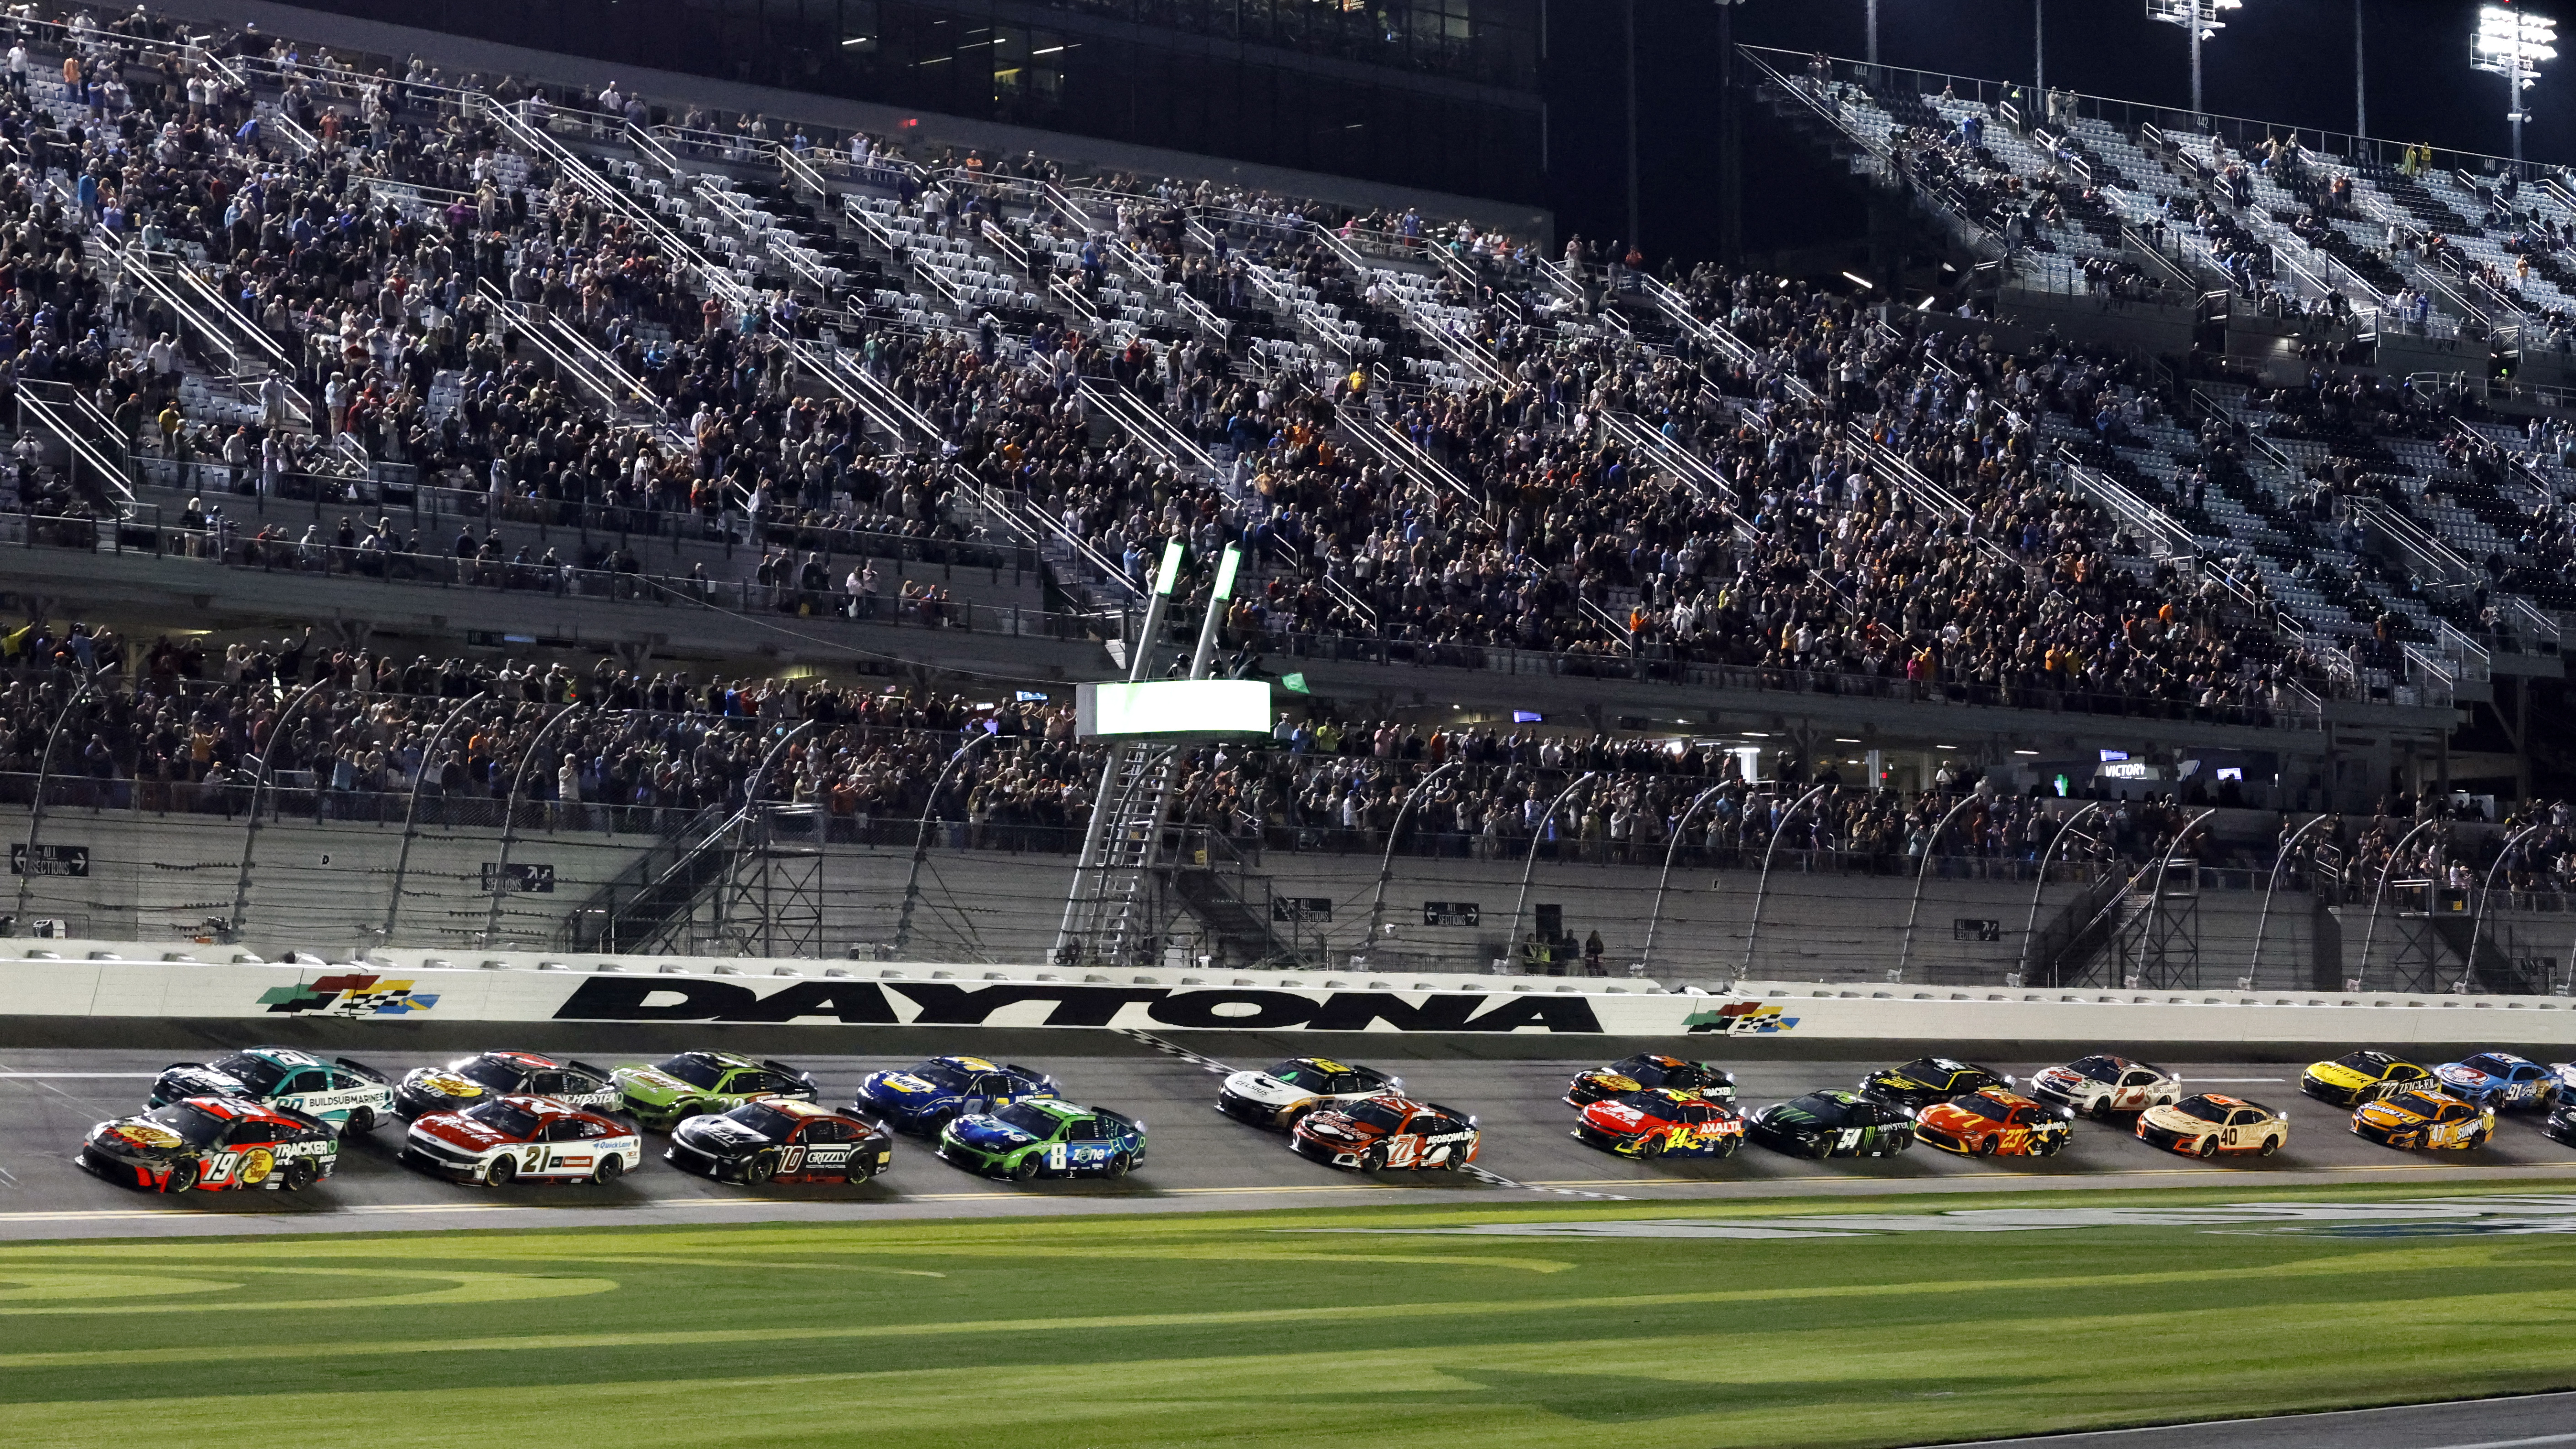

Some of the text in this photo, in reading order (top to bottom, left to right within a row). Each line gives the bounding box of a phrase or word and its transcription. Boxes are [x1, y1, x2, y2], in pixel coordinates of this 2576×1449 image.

[2197, 115, 2209, 128] 442
[2484, 158, 2495, 171] 440
[2106, 763, 2145, 777] VICTORY
[322, 855, 329, 865] D
[1300, 899, 1310, 910] ALL
[1438, 914, 1466, 926] SECTIONS
[552, 976, 1604, 1033] DAYTONA
[408, 1080, 446, 1098] CLUB
[894, 1077, 926, 1091] NAPA
[1235, 1080, 1269, 1096] CELSIUS
[1702, 1087, 1731, 1097] TRACKER
[2378, 1082, 2399, 1101] 77
[2399, 1078, 2435, 1094] ZEIGLER
[2506, 1083, 2523, 1101] 91
[309, 1093, 383, 1107] BUILDSUBMARINES
[2111, 1088, 2128, 1109] 7
[2360, 1101, 2408, 1118] SUNNY
[1699, 1121, 1741, 1134] AXALTA
[1877, 1122, 1909, 1132] MONSTER
[2032, 1121, 2067, 1131] McDonald's
[2431, 1124, 2446, 1142] 47
[2457, 1118, 2483, 1141] SUNNY
[1426, 1130, 1475, 1145] #GOBOWLING
[1666, 1127, 1690, 1148] 24
[1836, 1127, 1863, 1150] 54
[1999, 1129, 2024, 1148] 23
[2220, 1128, 2237, 1146] 40
[275, 1141, 328, 1158] TRACKER
[807, 1152, 850, 1164] GRIZZLY
[1050, 1142, 1067, 1170] 8
[203, 1152, 238, 1181] 19
[521, 1146, 551, 1173] 21
[777, 1146, 806, 1173] 10
